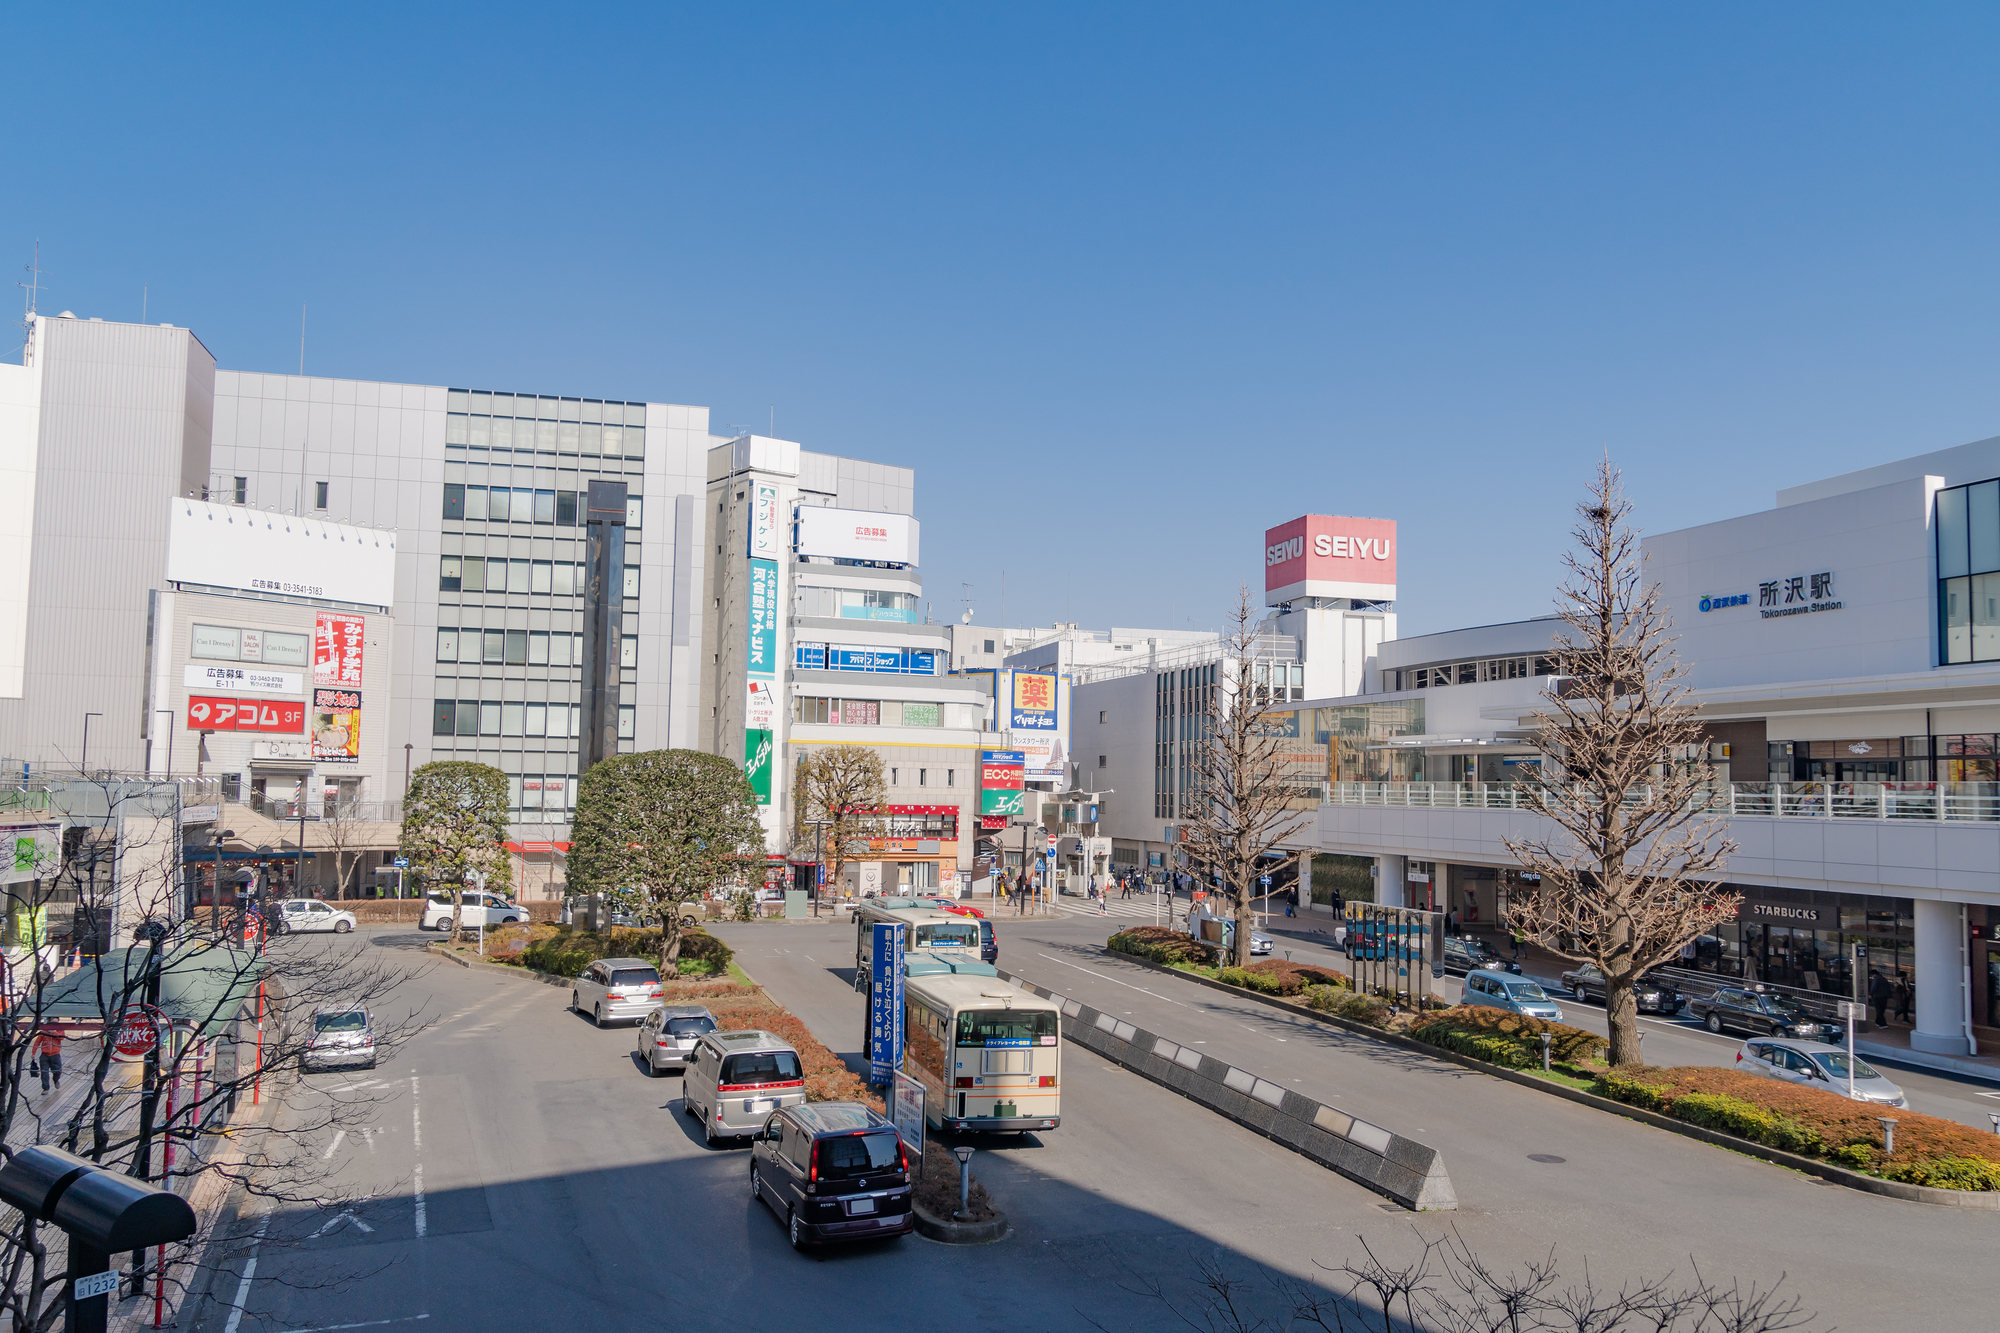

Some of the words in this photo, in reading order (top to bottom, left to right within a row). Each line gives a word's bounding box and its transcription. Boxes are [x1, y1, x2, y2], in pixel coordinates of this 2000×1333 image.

[759, 499, 768, 548] フジケン
[856, 527, 887, 537] 広告募集
[1267, 536, 1303, 567] SEIYU
[1315, 534, 1390, 560] SEIYU
[252, 579, 281, 590] 広告募集
[283, 583, 323, 595] 03-3541-5183
[1759, 572, 1833, 607] 所沢駅
[766, 569, 776, 630] 大学現役合格
[1713, 594, 1750, 609] 西武鉄道
[1760, 605, 1809, 619] Tokorozawa
[1811, 600, 1842, 612] Station
[751, 567, 766, 664] 河合塾マナビス
[213, 640, 231, 648] Dressy
[342, 623, 362, 681] みすず学苑
[850, 656, 894, 665] アパマンショップ
[207, 668, 244, 679] 広告募集
[216, 680, 234, 688] E-11
[1022, 676, 1048, 707] 薬
[215, 703, 278, 725] アコム
[284, 711, 301, 722] 3F
[745, 737, 772, 778] エイブル
[984, 769, 1010, 780] ECC
[1754, 904, 1817, 920] STARBUCKS
[884, 966, 892, 1041] 負けて泣くより
[874, 982, 882, 1053] 届ける勇気
[88, 1278, 116, 1295] 1232
